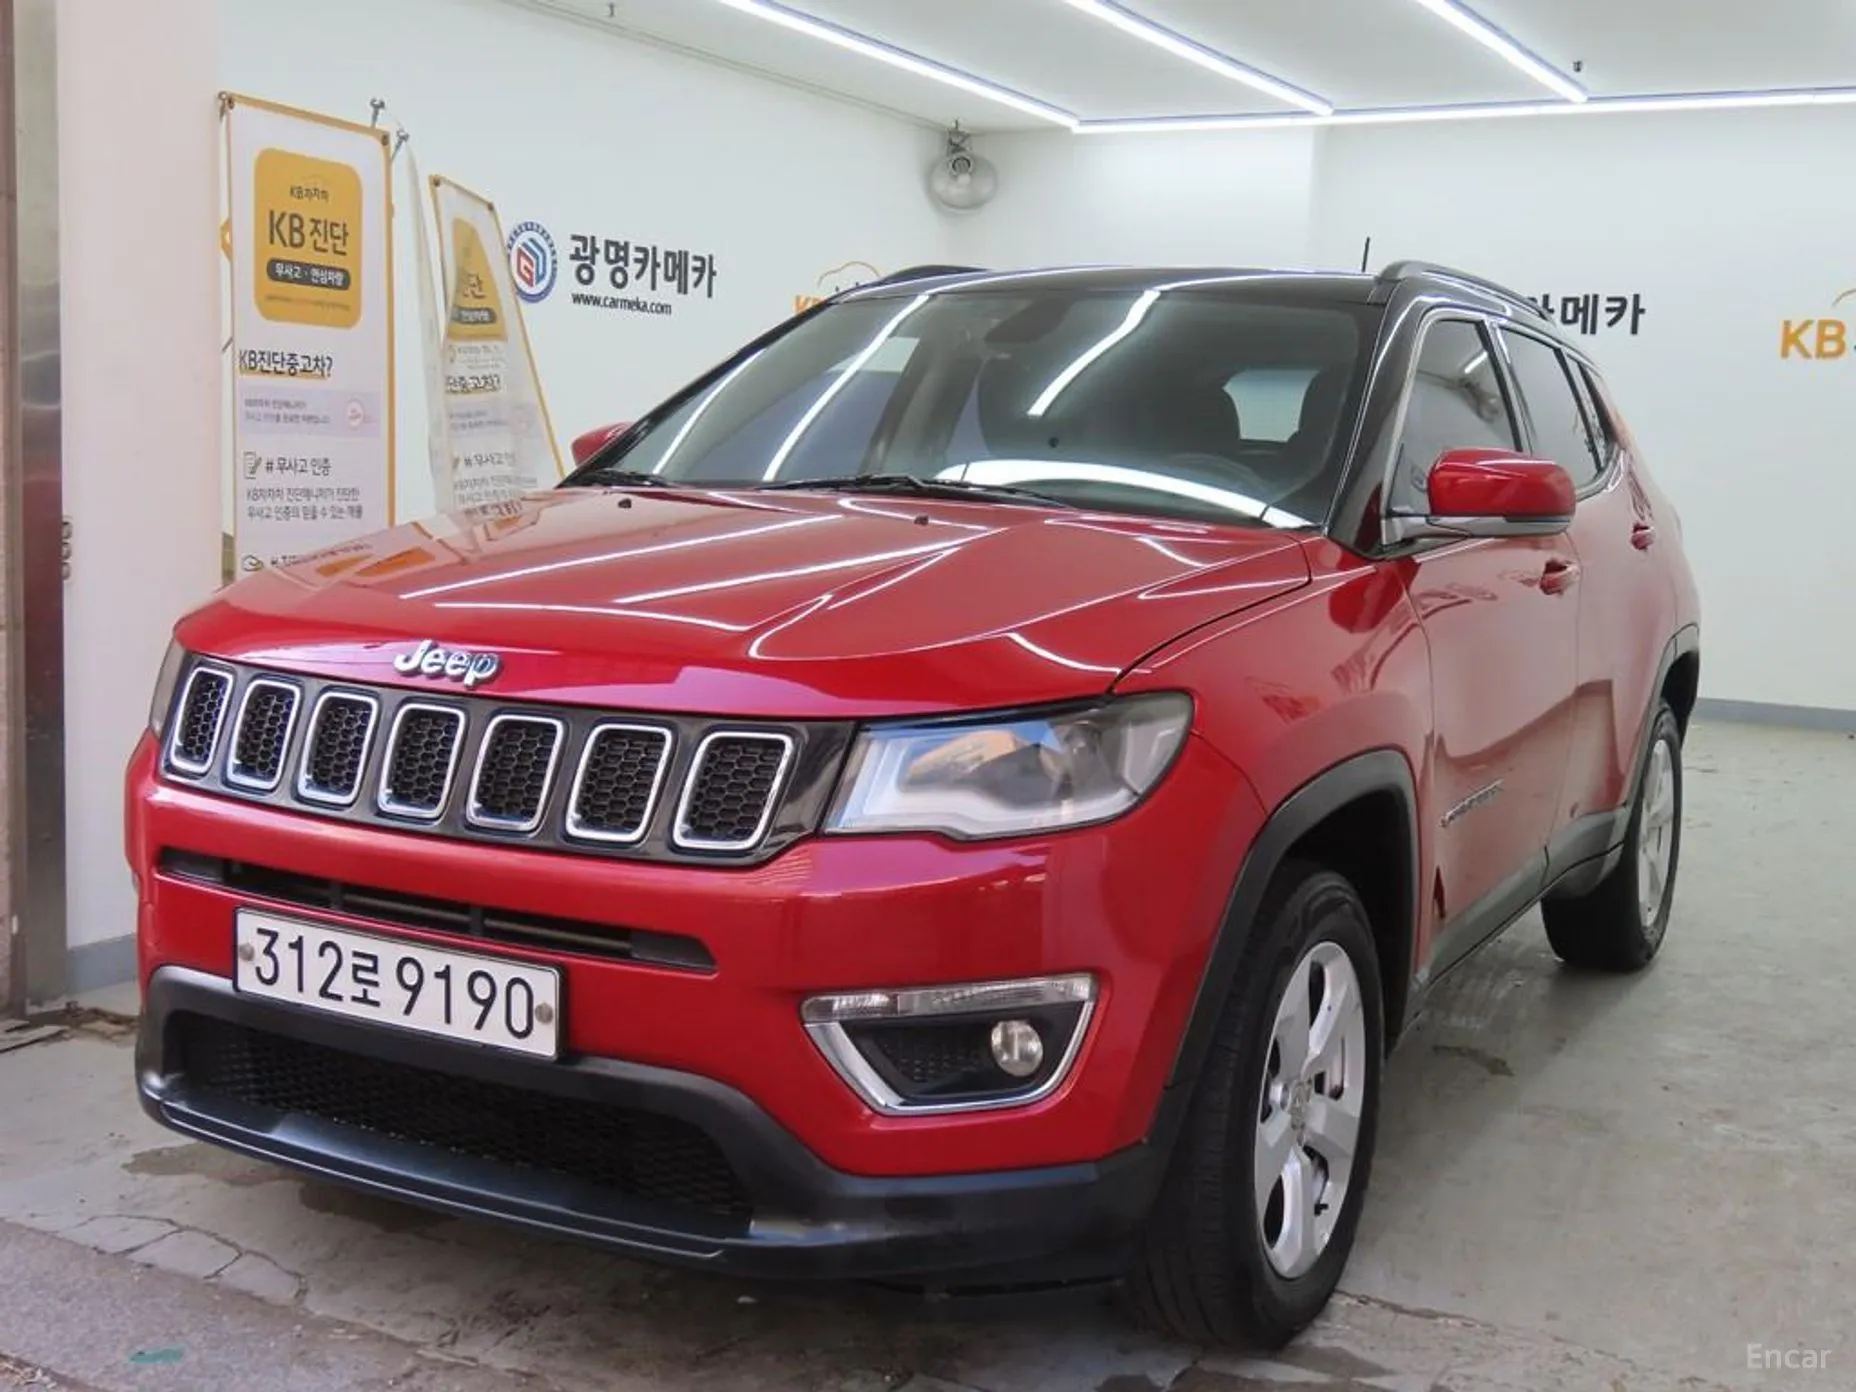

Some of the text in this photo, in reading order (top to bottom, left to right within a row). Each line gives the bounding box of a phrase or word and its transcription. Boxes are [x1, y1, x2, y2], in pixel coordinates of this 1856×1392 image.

[268, 209, 349, 256] KB 진단
[569, 234, 717, 298] 광명카메카
[571, 291, 672, 316] www.carmeka.com
[1781, 319, 1856, 359] KB
[239, 350, 334, 378] KB진단중고차?
[277, 456, 308, 477] 무사고
[394, 639, 500, 688] Jeep
